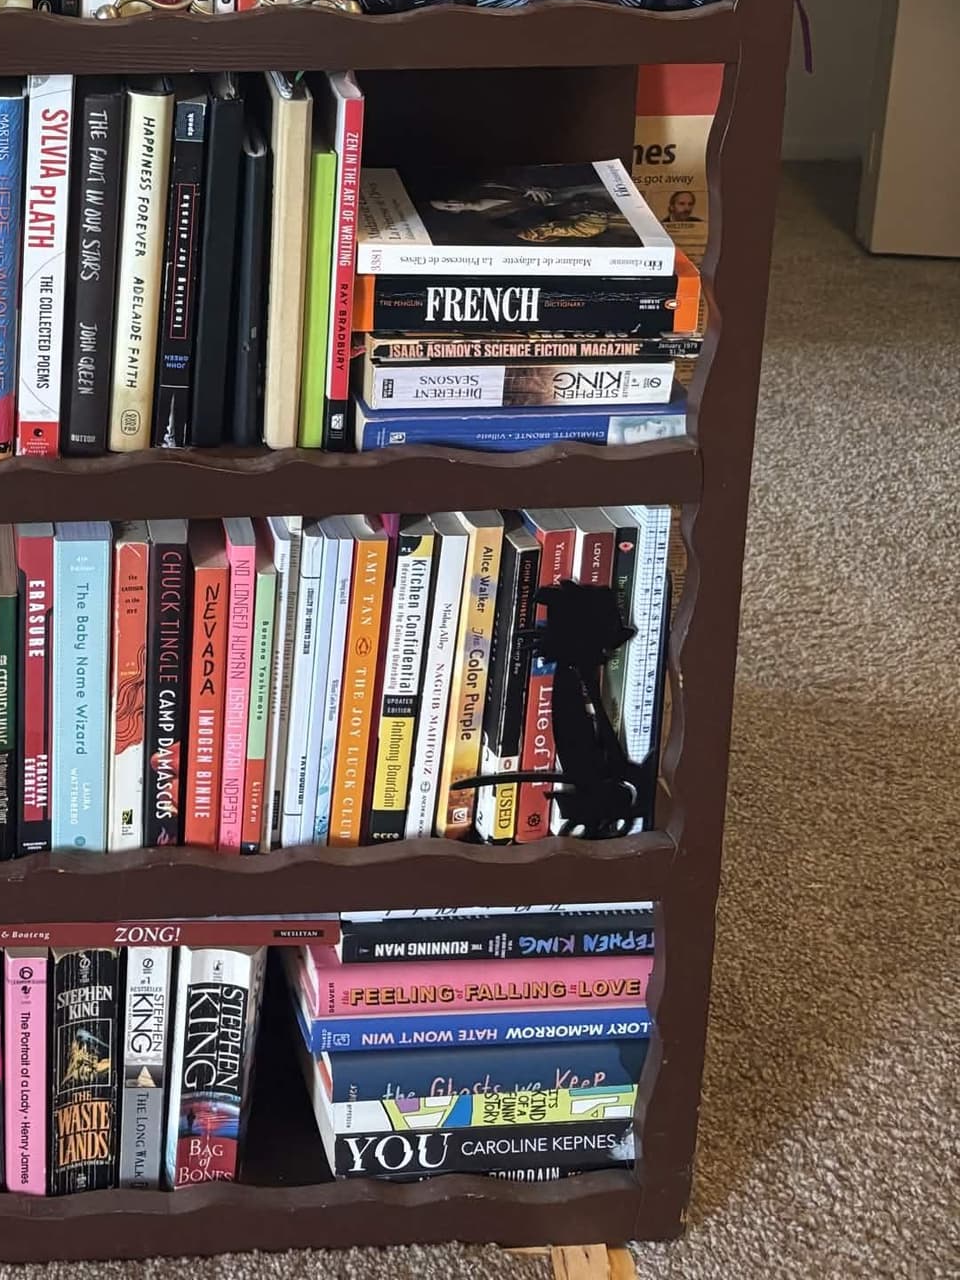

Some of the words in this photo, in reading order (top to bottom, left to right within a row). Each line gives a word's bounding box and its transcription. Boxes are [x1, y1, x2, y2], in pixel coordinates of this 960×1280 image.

[41, 109, 69, 179] SYLVIA
[140, 116, 156, 193] HAPPINESS
[28, 186, 56, 249] PLATH
[135, 196, 150, 257] FOREVER
[129, 276, 145, 343] ADELAIDE
[425, 286, 541, 323] FRENCH
[125, 346, 140, 389] FAITH
[389, 344, 424, 359] ISAAC
[426, 343, 483, 358] ASIMOV'S
[484, 344, 531, 357] SCIENCE
[534, 344, 578, 357] FICTION
[580, 343, 640, 356] MAGAZINE
[413, 387, 482, 400] DIFFERENT
[419, 375, 480, 385] SEASONS
[76, 582, 89, 609] The
[29, 579, 45, 657] ERASURE
[76, 615, 89, 651] Baby
[75, 656, 88, 699] Name
[157, 690, 175, 731] CAMP
[75, 706, 88, 755] Wizard
[156, 735, 175, 819] DAMASCUS
[499, 788, 512, 830] USED
[115, 927, 180, 943] ZONG!
[57, 985, 113, 1008] STEPHEN
[350, 986, 455, 1006] FEELING
[465, 982, 567, 1002] FALLING
[578, 979, 641, 997] LOVE
[132, 994, 152, 1054] KING
[185, 987, 221, 1090] KING
[222, 986, 244, 1091] STEPHEN
[362, 1033, 395, 1045] WIN
[399, 1029, 454, 1043] WON'T
[458, 1029, 497, 1041] HATE
[56, 1101, 109, 1135] WASTE
[59, 1131, 108, 1163] LANDS
[190, 1139, 224, 1157] BAG
[344, 1133, 453, 1172] YOU
[461, 1137, 548, 1156] CAROLINE
[552, 1133, 617, 1150] KEPNES
